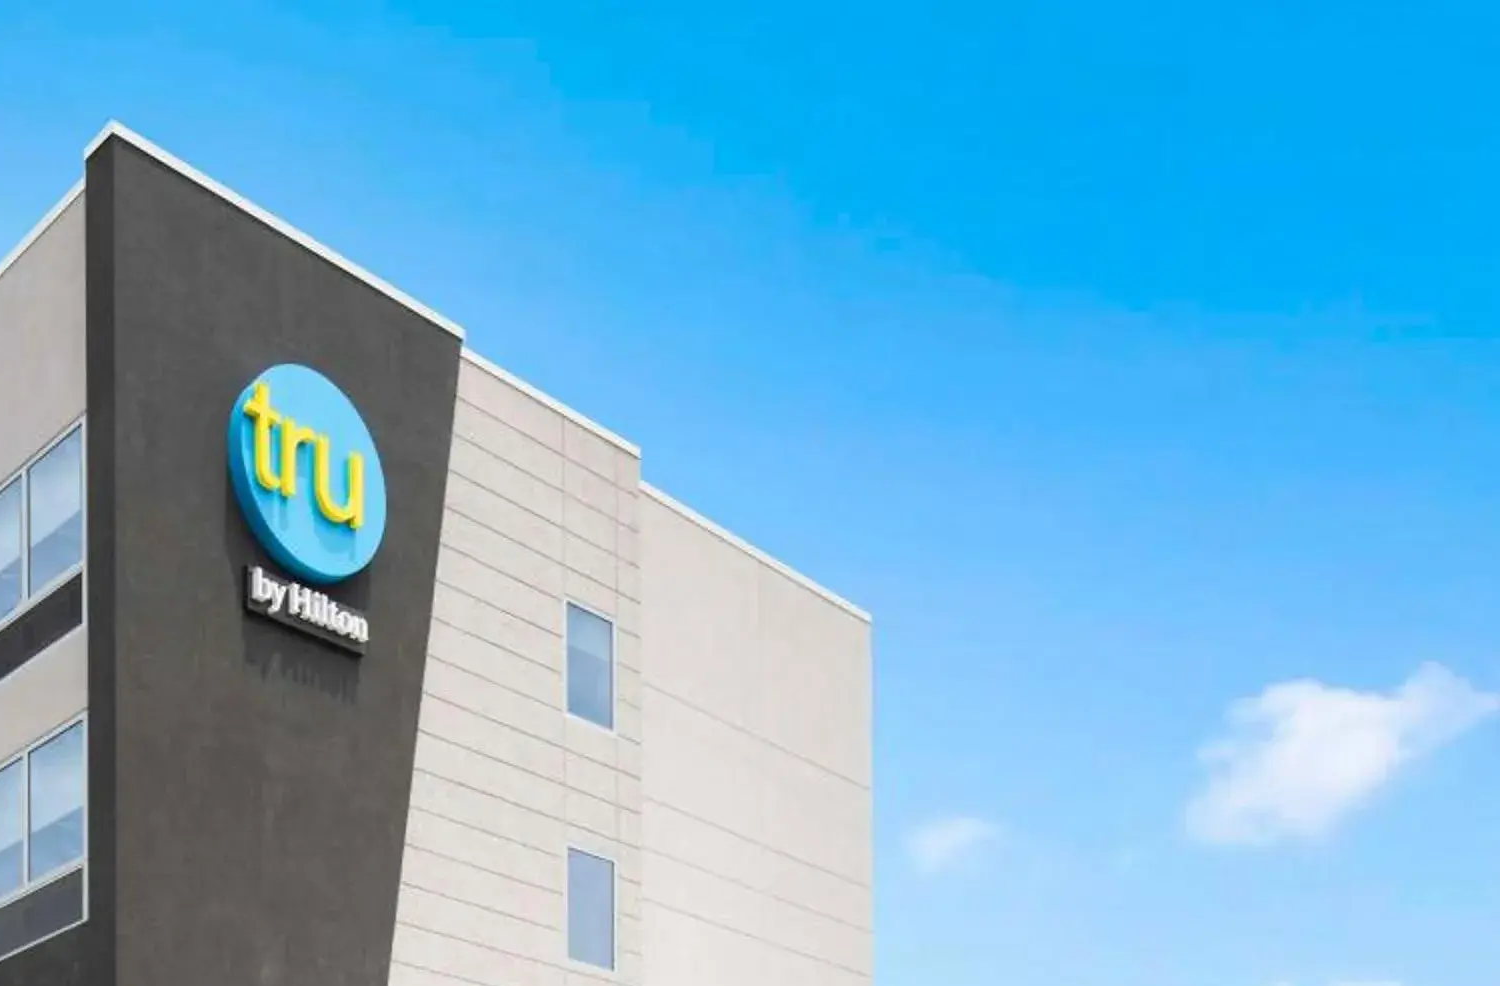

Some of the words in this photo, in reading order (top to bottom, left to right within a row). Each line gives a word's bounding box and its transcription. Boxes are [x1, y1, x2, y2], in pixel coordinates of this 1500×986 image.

[244, 382, 364, 530] tru
[252, 566, 287, 615] by
[288, 582, 369, 642] Hilton
